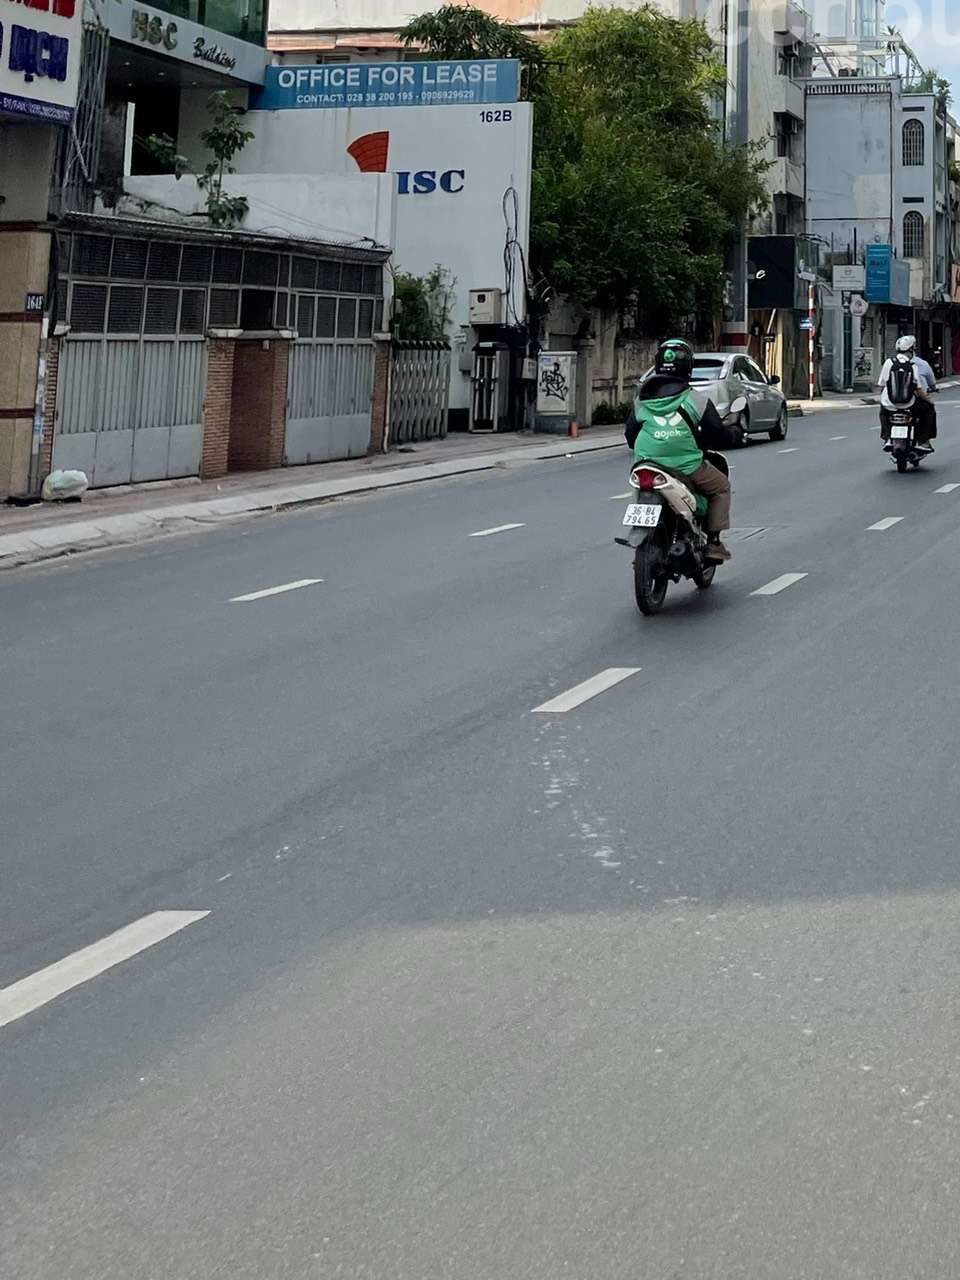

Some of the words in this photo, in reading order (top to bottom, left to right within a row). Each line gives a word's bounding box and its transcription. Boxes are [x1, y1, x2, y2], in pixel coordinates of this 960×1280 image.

[9, 23, 69, 82] DỊCH
[278, 68, 361, 88] OFFICE
[367, 66, 415, 86] FOR
[422, 63, 498, 84] LEASE
[296, 93, 344, 104] CONTACT:
[479, 110, 513, 123] 162B
[396, 169, 465, 195] ISC
